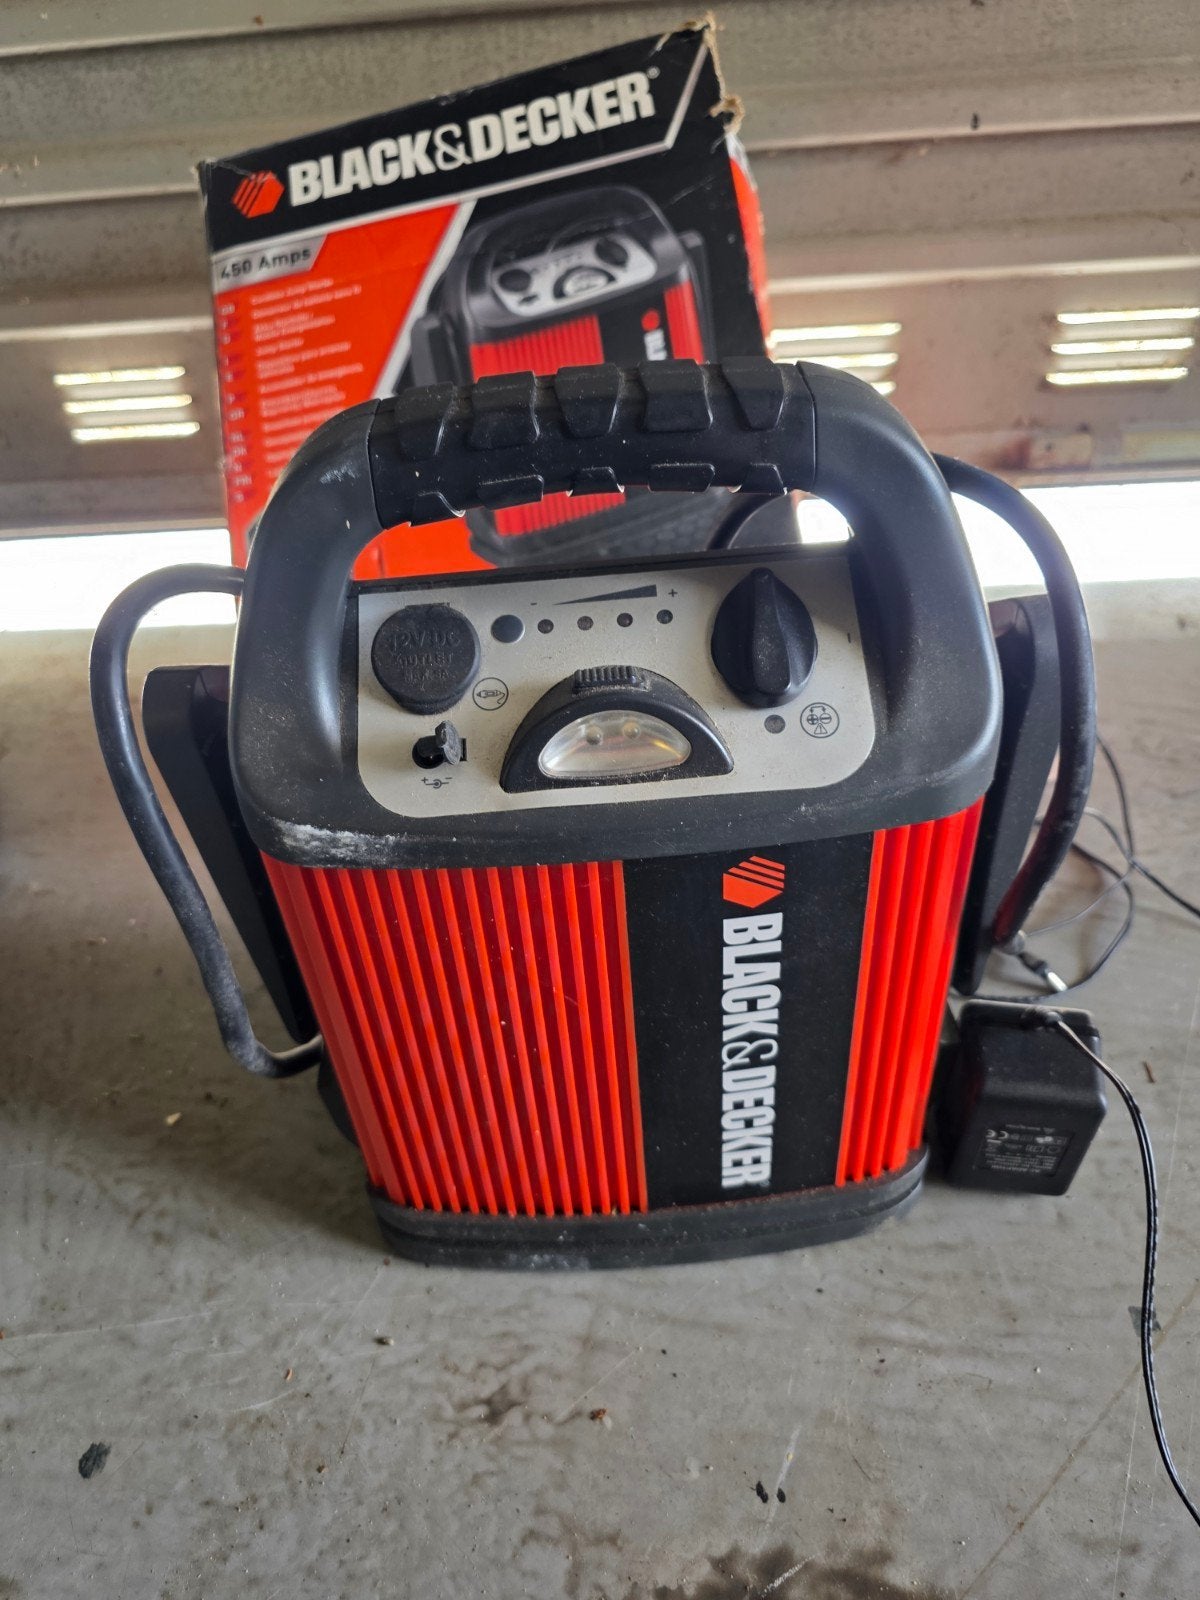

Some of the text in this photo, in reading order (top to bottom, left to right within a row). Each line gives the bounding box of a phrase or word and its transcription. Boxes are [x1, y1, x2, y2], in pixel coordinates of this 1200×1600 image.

[220, 249, 312, 279] 450 Amps
[722, 912, 783, 1188] BLACK&DECKER
